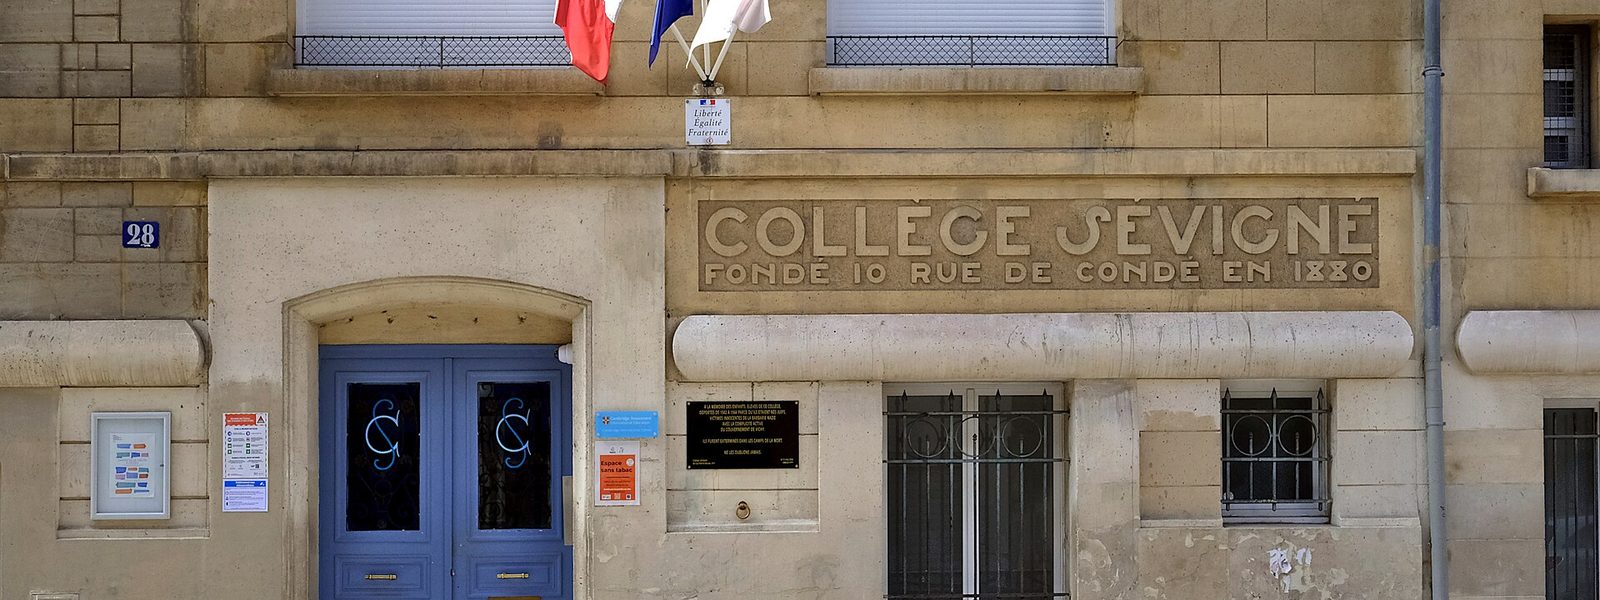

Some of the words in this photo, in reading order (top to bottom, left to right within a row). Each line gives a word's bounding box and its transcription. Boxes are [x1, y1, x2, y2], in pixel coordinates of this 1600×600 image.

[694, 109, 722, 117] Liberté
[694, 117, 722, 128] Égalité
[688, 128, 729, 136] Fraternité
[127, 223, 155, 245] 28
[704, 198, 1031, 257] COLLÈGE
[1055, 197, 1373, 256] SÉVIGNÉ
[704, 257, 830, 285] FONDÉ
[911, 262, 981, 284] RUE
[1004, 261, 1052, 284] DE
[1076, 256, 1200, 283] CONDÉ
[1222, 260, 1271, 283] EN
[1294, 260, 1373, 283] 1880
